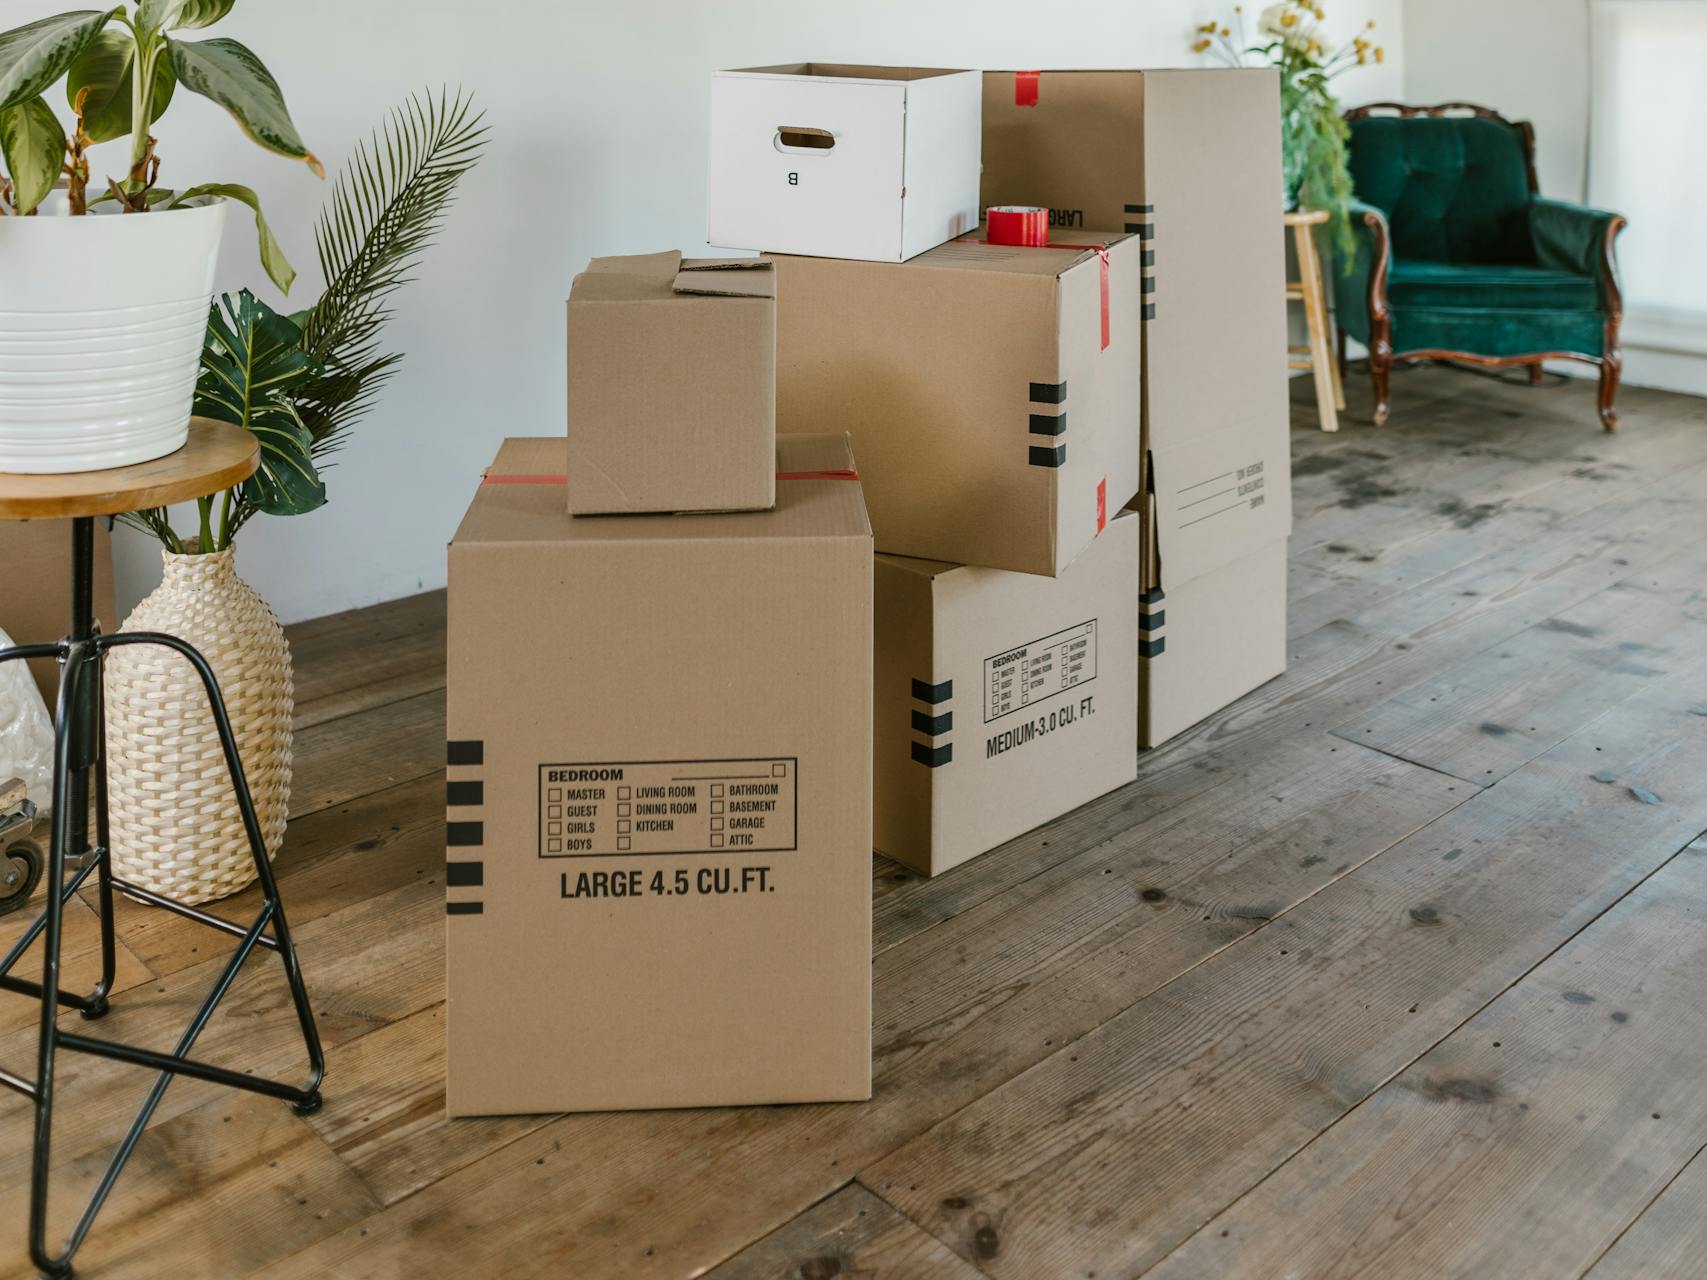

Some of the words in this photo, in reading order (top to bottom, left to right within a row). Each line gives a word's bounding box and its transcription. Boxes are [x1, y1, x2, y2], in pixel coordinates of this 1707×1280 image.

[788, 172, 798, 185] B
[1048, 209, 1083, 228] LARG
[993, 649, 1027, 668] BEDROOM
[987, 712, 1056, 759] MEDIUM-3.0
[1060, 704, 1077, 727] CU.
[1081, 696, 1095, 718] FT.
[548, 769, 624, 783] BEDROOM
[567, 788, 605, 801] MASTER
[636, 786, 666, 799] LIVING
[668, 786, 695, 798] ROOM
[729, 783, 778, 796] BATHROOM
[567, 805, 597, 817] GUEST
[636, 803, 666, 816] DINING
[669, 802, 697, 815] ROOM
[729, 800, 776, 813] BASEMENT
[567, 821, 595, 834] GIRLS
[636, 820, 674, 832] KITCHEN
[729, 817, 765, 830] GARAGE
[567, 838, 592, 851] BOYS
[729, 833, 753, 846] ATTIC
[560, 870, 643, 899] LARGE
[650, 869, 689, 896] 4.5
